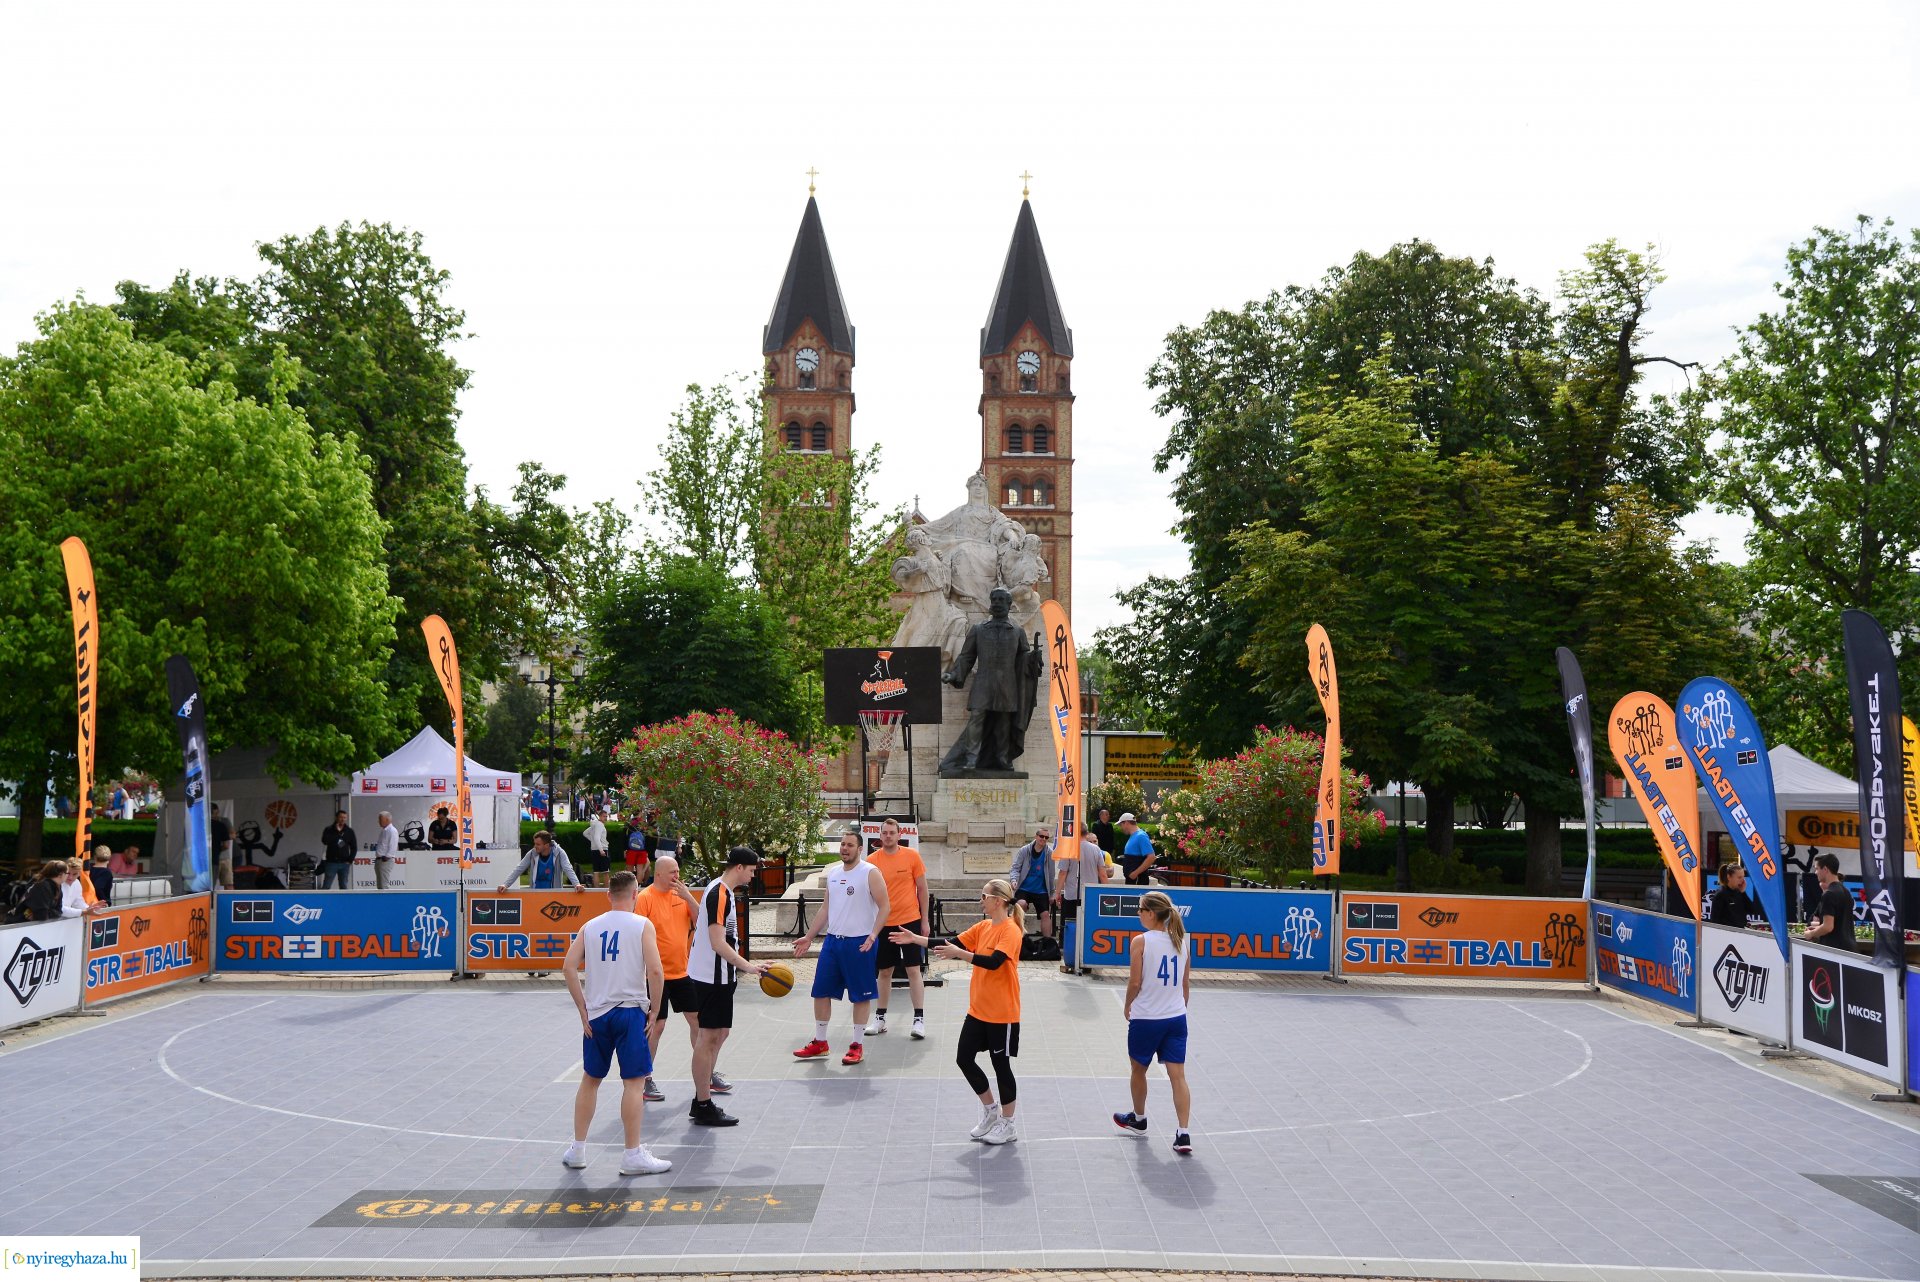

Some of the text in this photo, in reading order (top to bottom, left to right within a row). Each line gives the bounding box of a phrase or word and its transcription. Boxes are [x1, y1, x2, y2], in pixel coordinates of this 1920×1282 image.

[955, 789, 1017, 803] KOSSUTH
[291, 907, 323, 921] TOTI
[548, 905, 582, 918] TOTI
[1428, 911, 1460, 924] TOTI
[133, 919, 151, 934] TOTI
[225, 934, 419, 960] STREETBALL
[468, 932, 577, 960] STREE
[600, 930, 620, 962] 14
[1091, 929, 1291, 960] STTBALL
[1344, 936, 1552, 969] STREETBALL
[19, 945, 66, 992] TOTI
[86, 939, 192, 989] STREETBALL
[1157, 954, 1178, 987] 41
[1598, 947, 1679, 995] STREETBALL
[1724, 958, 1771, 1005] TOTI
[1847, 1002, 1883, 1024] MKOSZ
